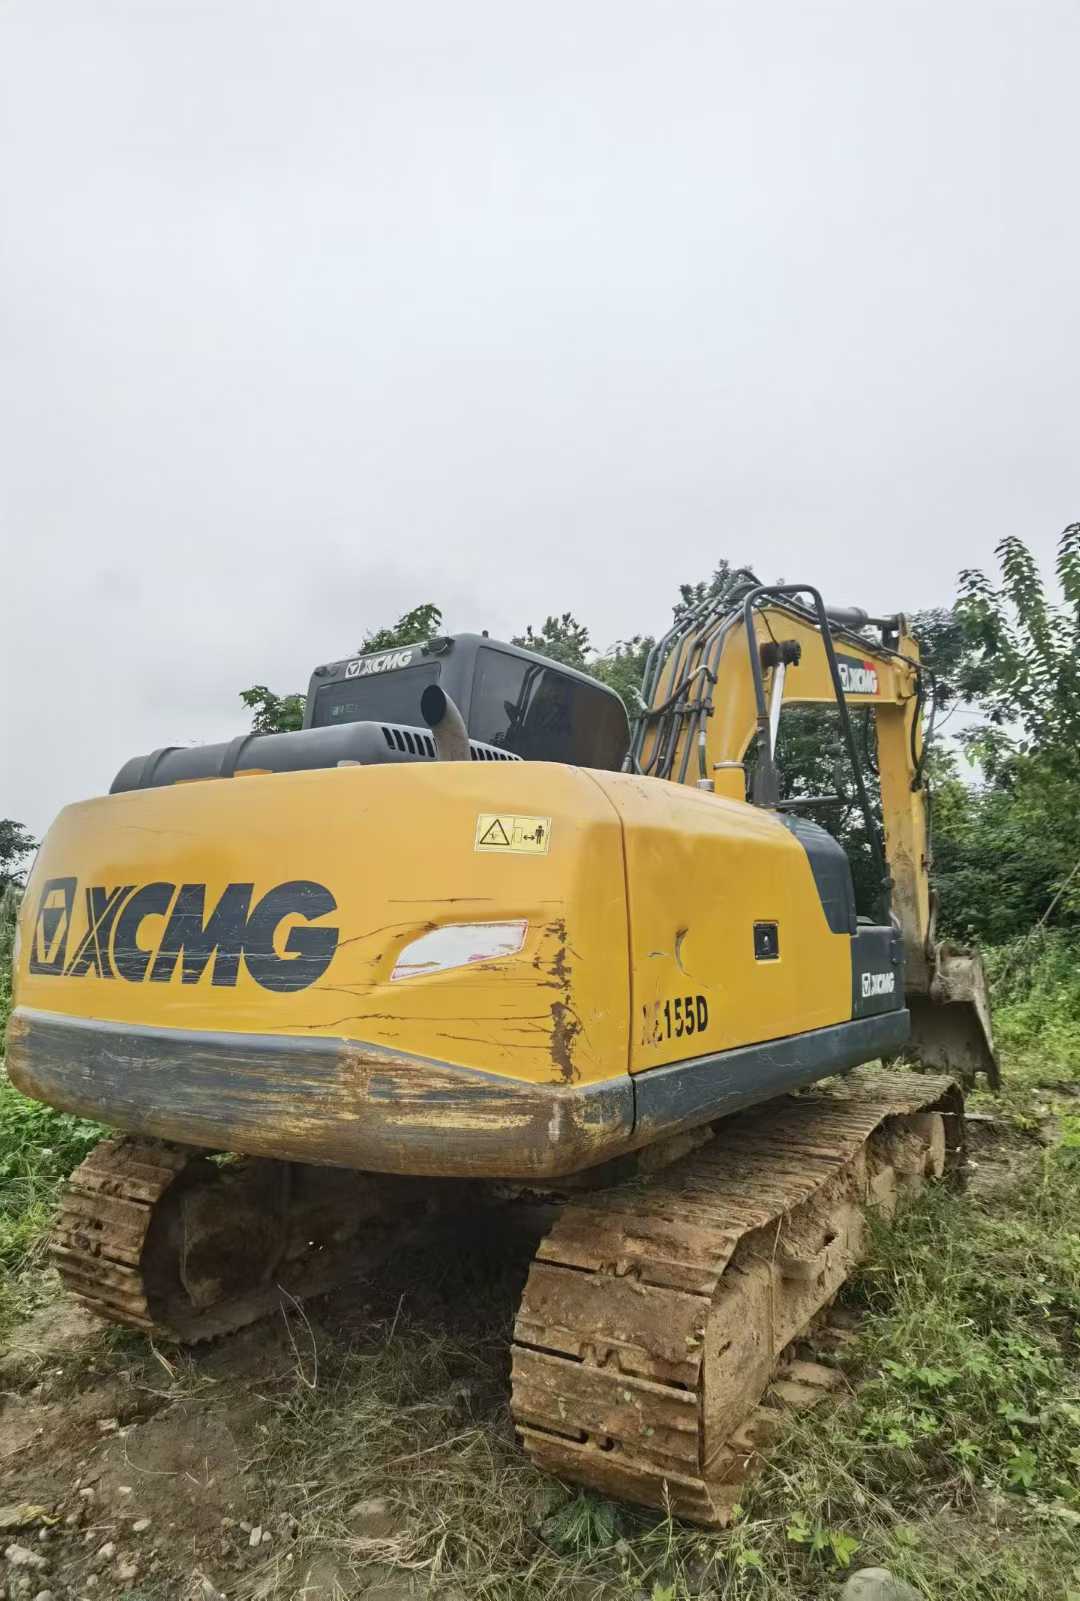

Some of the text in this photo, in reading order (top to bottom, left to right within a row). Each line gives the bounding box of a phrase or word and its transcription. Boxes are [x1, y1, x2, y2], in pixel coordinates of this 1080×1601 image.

[360, 651, 412, 674] XCMG
[849, 668, 877, 693] XCMG
[68, 880, 340, 993] XCMG
[870, 972, 895, 996] XCMG
